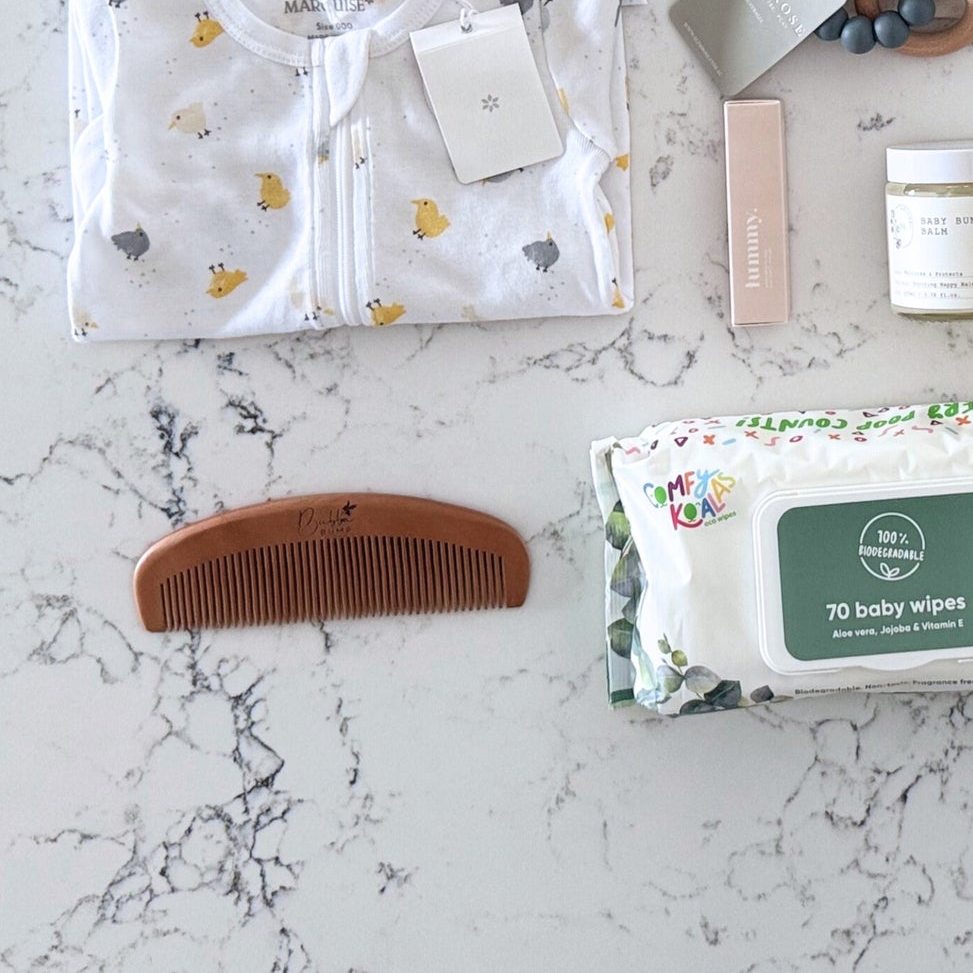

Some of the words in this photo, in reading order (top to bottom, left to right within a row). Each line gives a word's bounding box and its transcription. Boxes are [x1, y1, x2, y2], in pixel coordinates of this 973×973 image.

[920, 217, 947, 225] BABY
[921, 227, 948, 235] BALM
[735, 417, 848, 432] COUNTS!
[670, 471, 736, 531] KOALAS
[704, 519, 716, 527] eco
[718, 511, 736, 523] wipes
[877, 529, 910, 545] 100%
[858, 545, 925, 561] BIODEGRADABLE
[826, 603, 850, 621] 70
[855, 599, 904, 619] baby
[909, 595, 966, 616] wipes
[832, 629, 853, 639] Aloe
[854, 629, 878, 637] vera,
[880, 624, 912, 636] Jojoba
[912, 623, 920, 631] &
[922, 619, 956, 631] Vitamin
[958, 619, 964, 627] E
